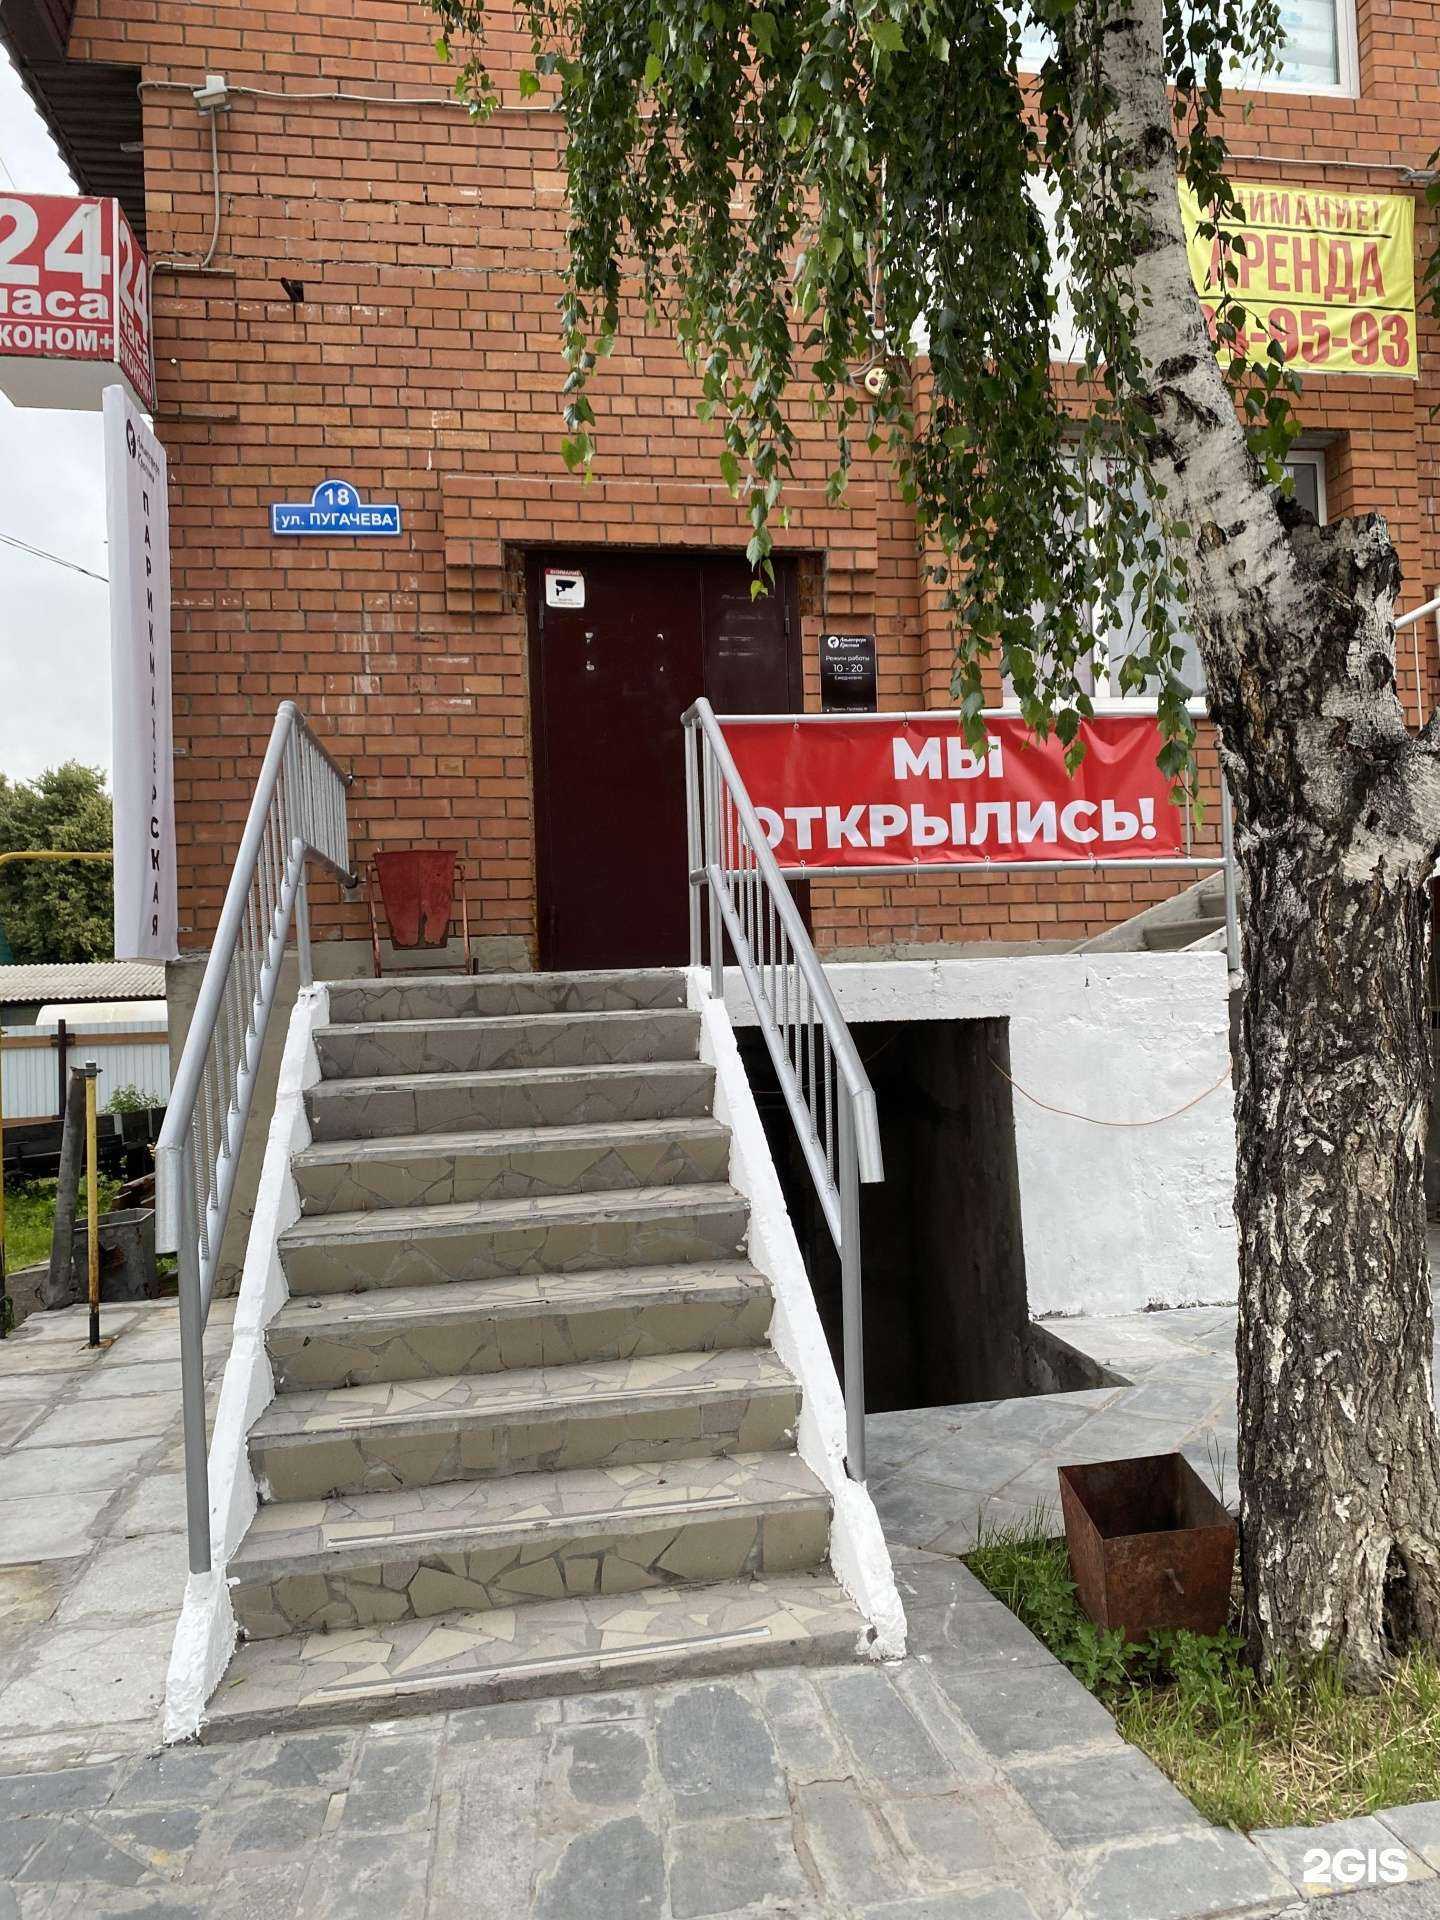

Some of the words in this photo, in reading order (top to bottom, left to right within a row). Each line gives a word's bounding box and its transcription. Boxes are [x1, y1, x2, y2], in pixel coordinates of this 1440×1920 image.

[1209, 190, 1380, 231] ИМАНИЕ!
[0, 198, 111, 290] 24
[119, 219, 149, 343] 24
[1209, 232, 1385, 304] АРЕНДА
[324, 488, 350, 505] 18
[281, 514, 304, 527] ул.
[310, 512, 393, 526] ПУГАЧЕВА
[833, 664, 843, 672] 10
[851, 664, 863, 672] 20
[847, 654, 870, 662] работы
[892, 736, 1004, 779] МЫ
[740, 798, 1157, 850] ОТКРЫЛИСЬ!
